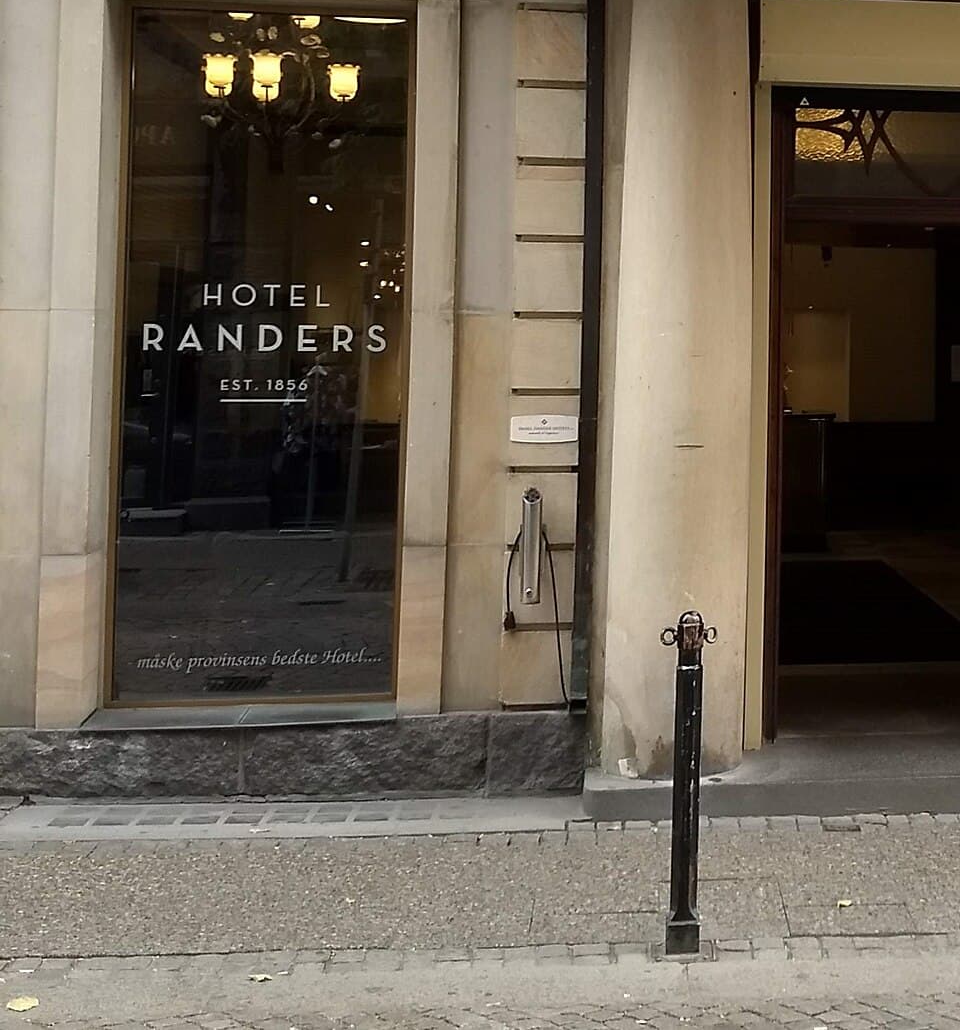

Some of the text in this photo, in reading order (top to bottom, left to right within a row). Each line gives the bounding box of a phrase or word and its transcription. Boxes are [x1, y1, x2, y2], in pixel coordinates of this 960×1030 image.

[202, 283, 331, 308] HOTEL
[141, 322, 388, 354] RANDERS
[219, 377, 309, 392] EST. 1856
[136, 652, 183, 671] måske
[185, 652, 268, 674] provinsens
[271, 649, 318, 665] bedste
